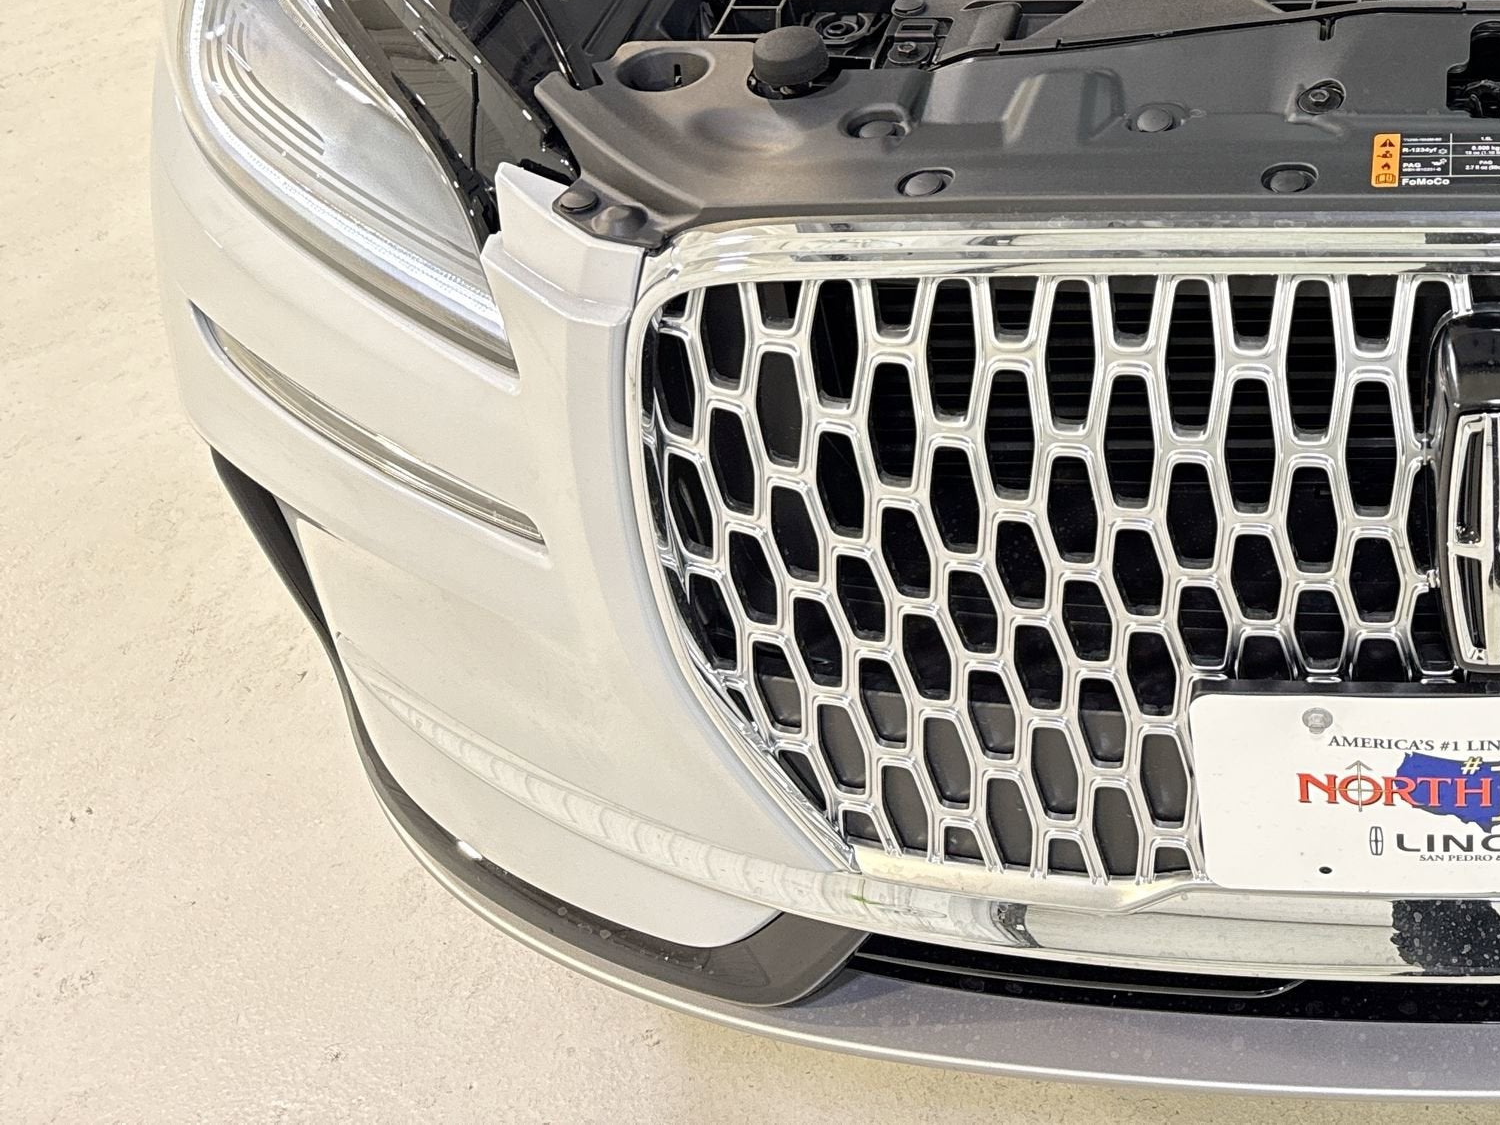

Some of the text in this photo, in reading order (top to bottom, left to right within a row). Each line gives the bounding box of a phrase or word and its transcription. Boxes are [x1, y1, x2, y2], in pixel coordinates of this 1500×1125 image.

[1402, 146, 1438, 154] R-1234yf
[1402, 177, 1450, 186] FoMoCo
[1328, 735, 1435, 751] AMERICA'S
[1440, 740, 1460, 751] #1
[1297, 773, 1492, 807] NORTH
[1419, 853, 1445, 861] SAN
[1448, 853, 1493, 861] PEDRO
